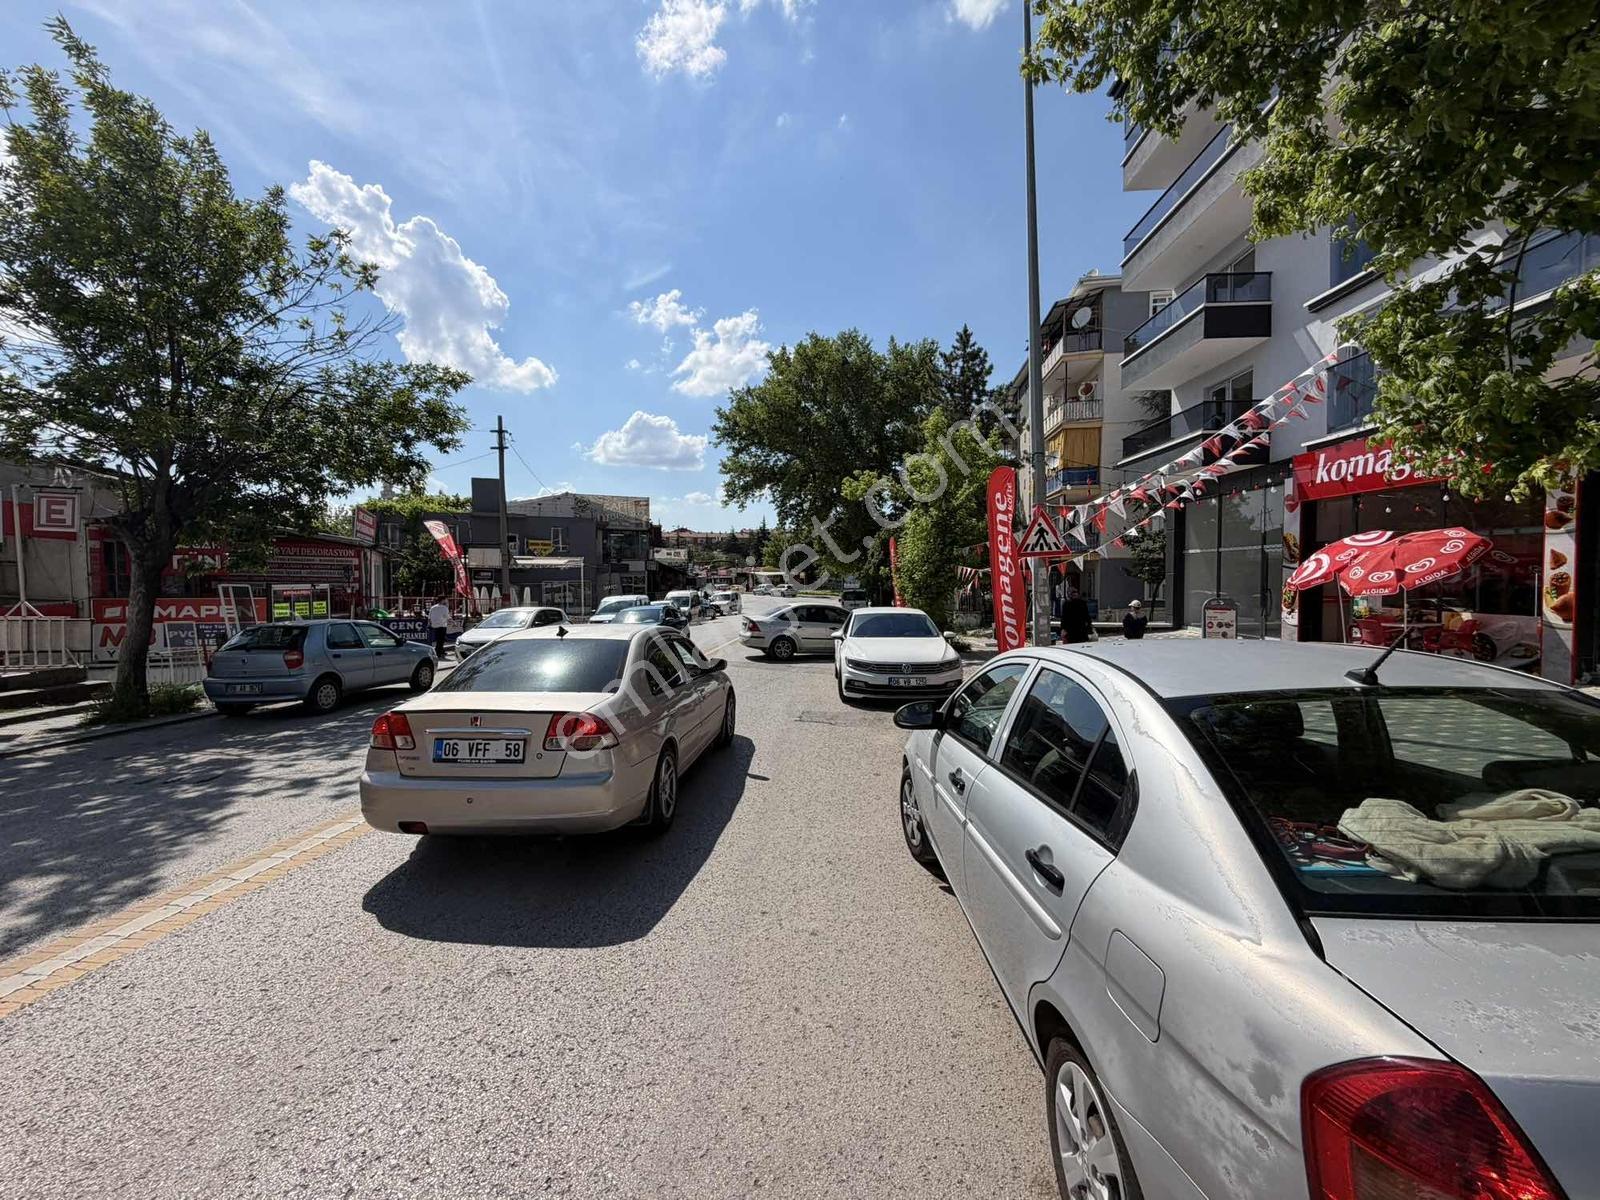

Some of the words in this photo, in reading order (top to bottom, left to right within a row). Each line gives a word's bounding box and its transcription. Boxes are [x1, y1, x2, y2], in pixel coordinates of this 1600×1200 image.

[301, 547, 355, 557] DEKORASYON
[995, 492, 1020, 650] omagene
[1415, 569, 1448, 585] ALGIDA
[125, 605, 255, 619] MAPEN
[389, 621, 423, 631] GENÇ
[443, 742, 459, 757] 06
[468, 742, 490, 757] VFF
[505, 742, 520, 758] 58
